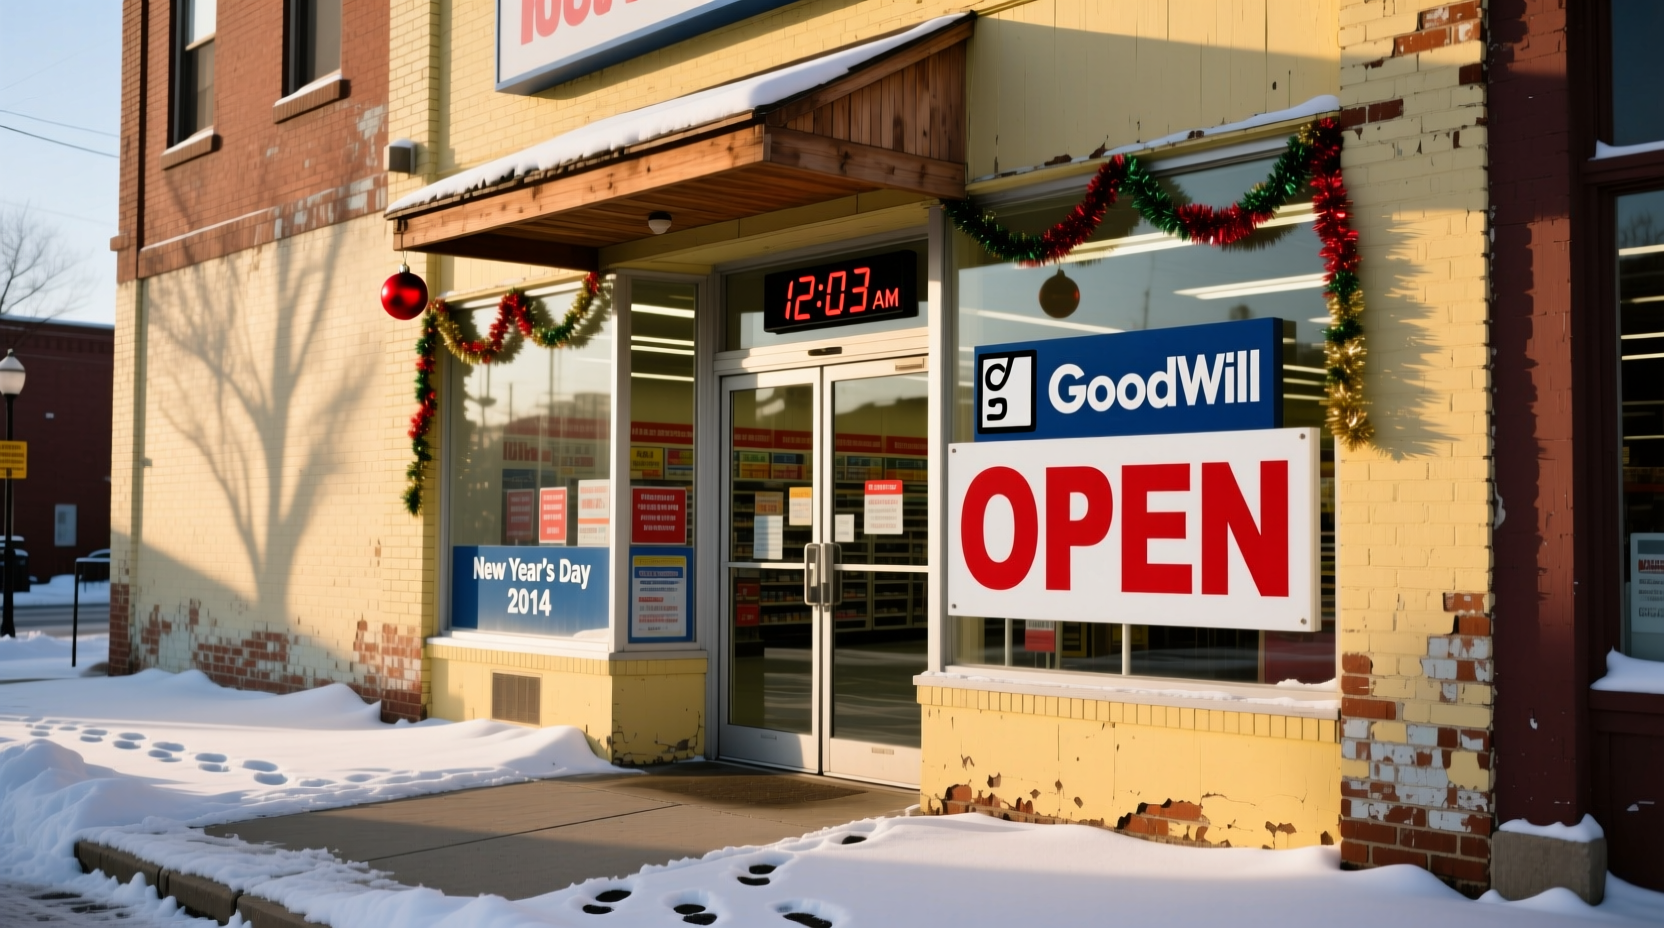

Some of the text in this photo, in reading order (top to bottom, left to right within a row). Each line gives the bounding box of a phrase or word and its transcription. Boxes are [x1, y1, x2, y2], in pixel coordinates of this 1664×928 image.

[785, 267, 899, 321] 12:03 AM
[1048, 349, 1260, 414] GoodWill
[960, 460, 1290, 598] OPEN
[473, 556, 592, 590] New Year's Day
[507, 587, 552, 617] 2014
